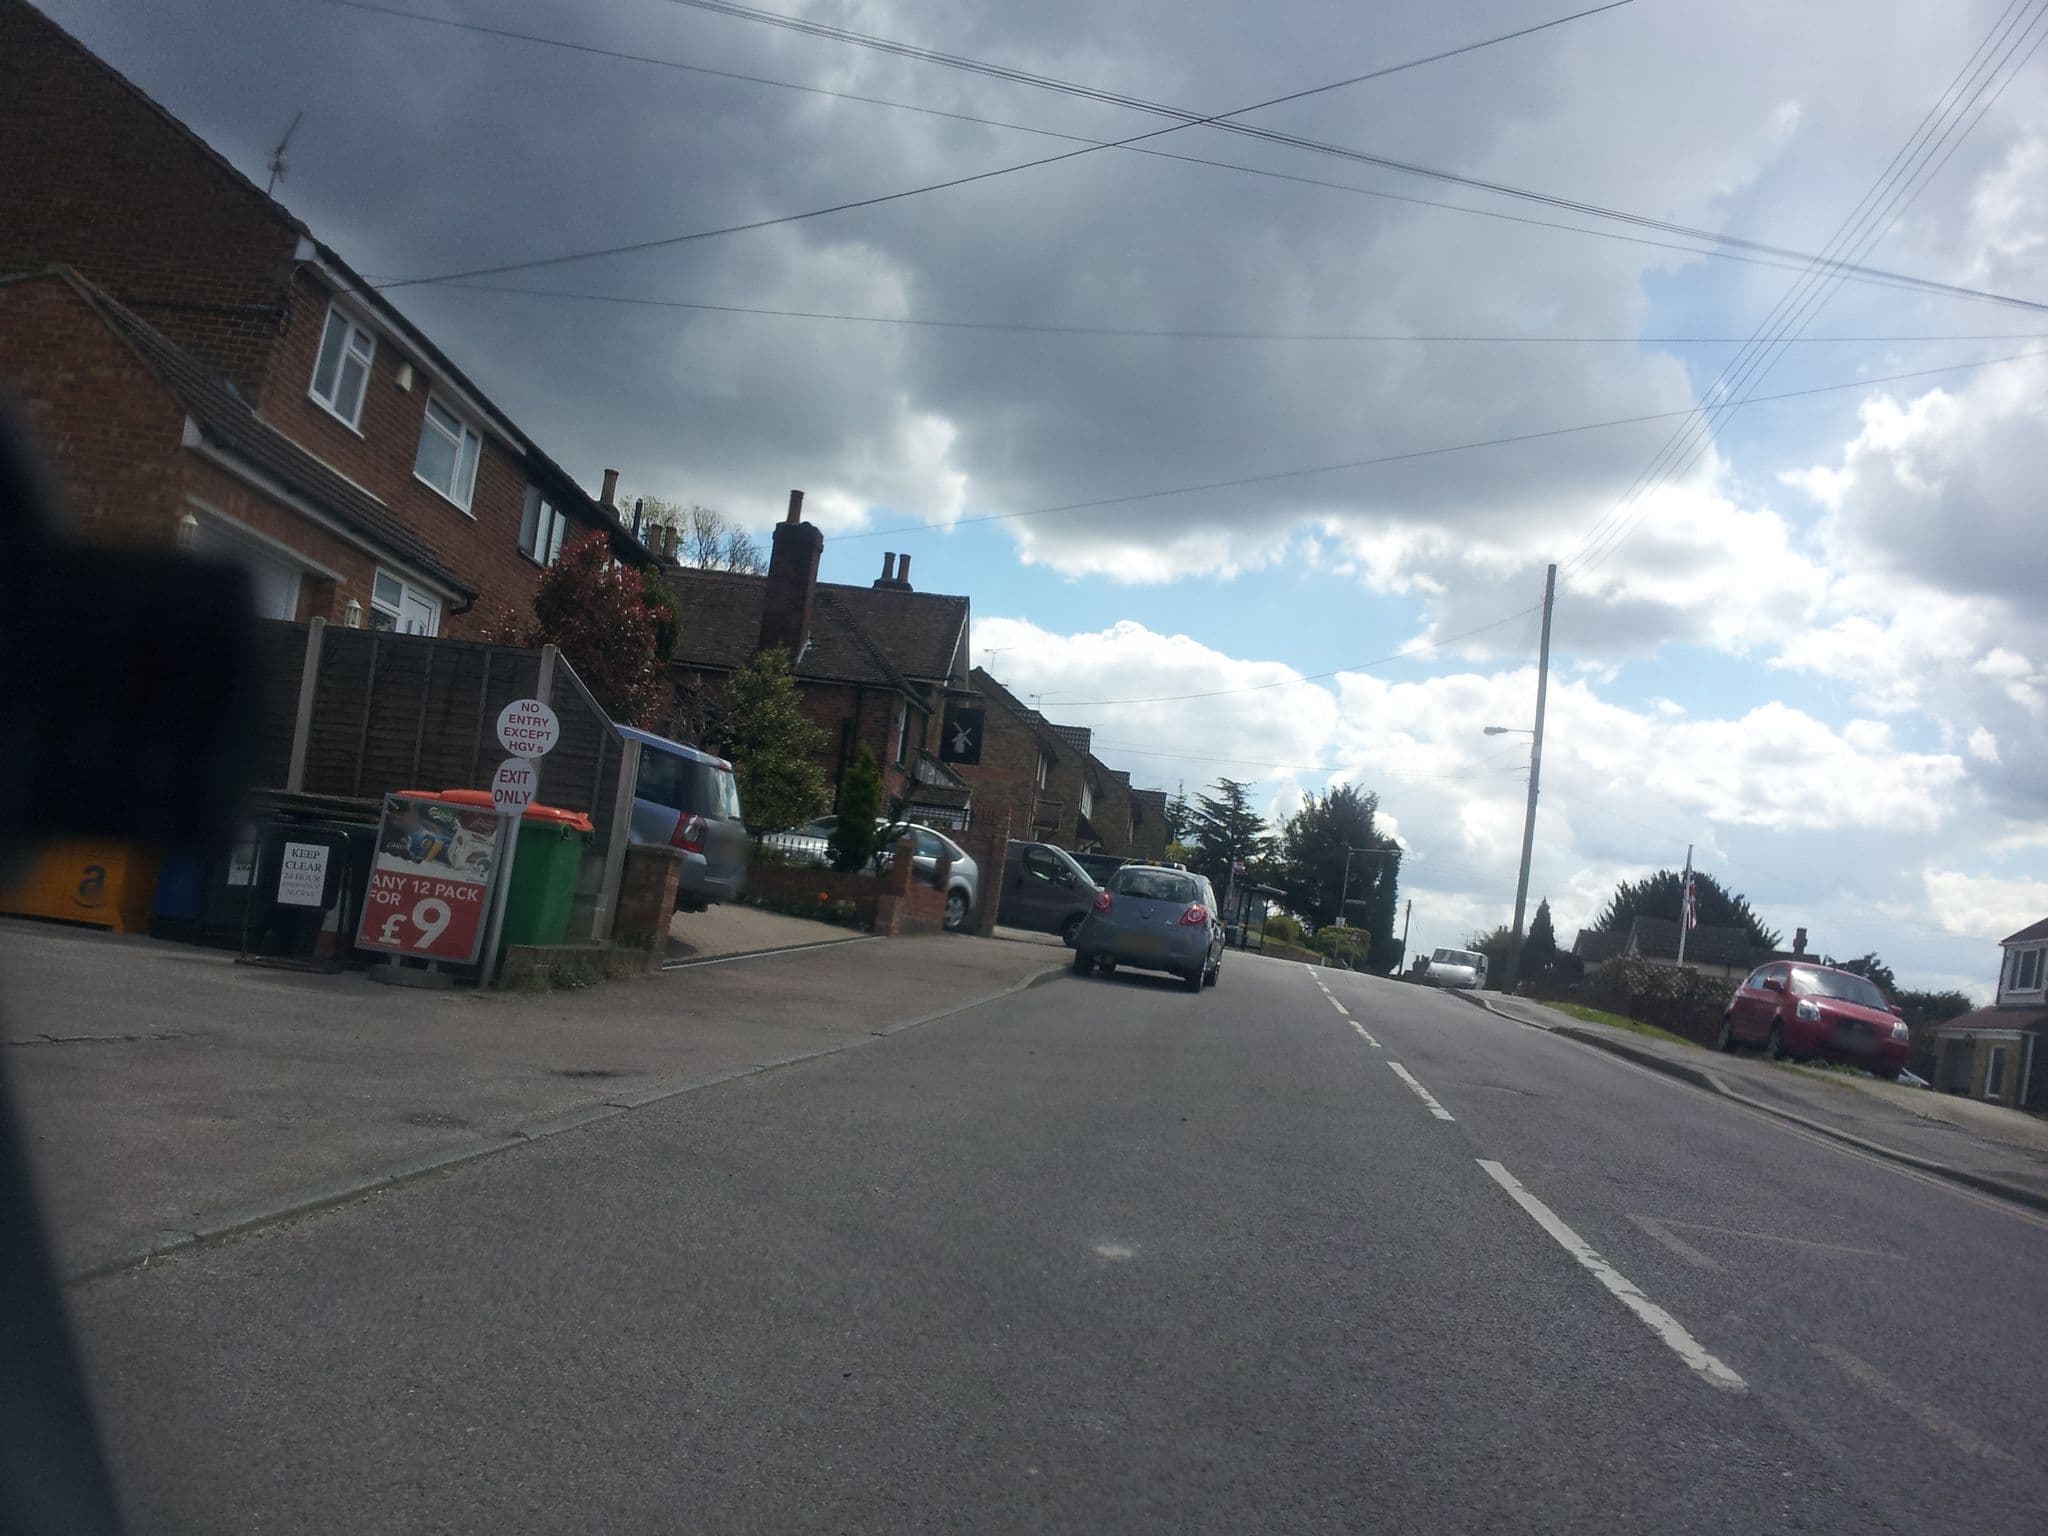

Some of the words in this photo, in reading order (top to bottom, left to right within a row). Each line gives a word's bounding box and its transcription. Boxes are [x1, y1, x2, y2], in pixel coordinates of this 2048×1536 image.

[521, 702, 540, 713] NO
[508, 714, 549, 727] ENTRY
[503, 727, 552, 741] EXCEPT
[500, 769, 530, 785] EXIT
[494, 788, 531, 805] ONLY
[291, 848, 320, 860] KEEP
[285, 860, 322, 872] CLEAR
[372, 873, 407, 890] ANY
[412, 879, 430, 895] 12
[434, 883, 480, 902] PACK
